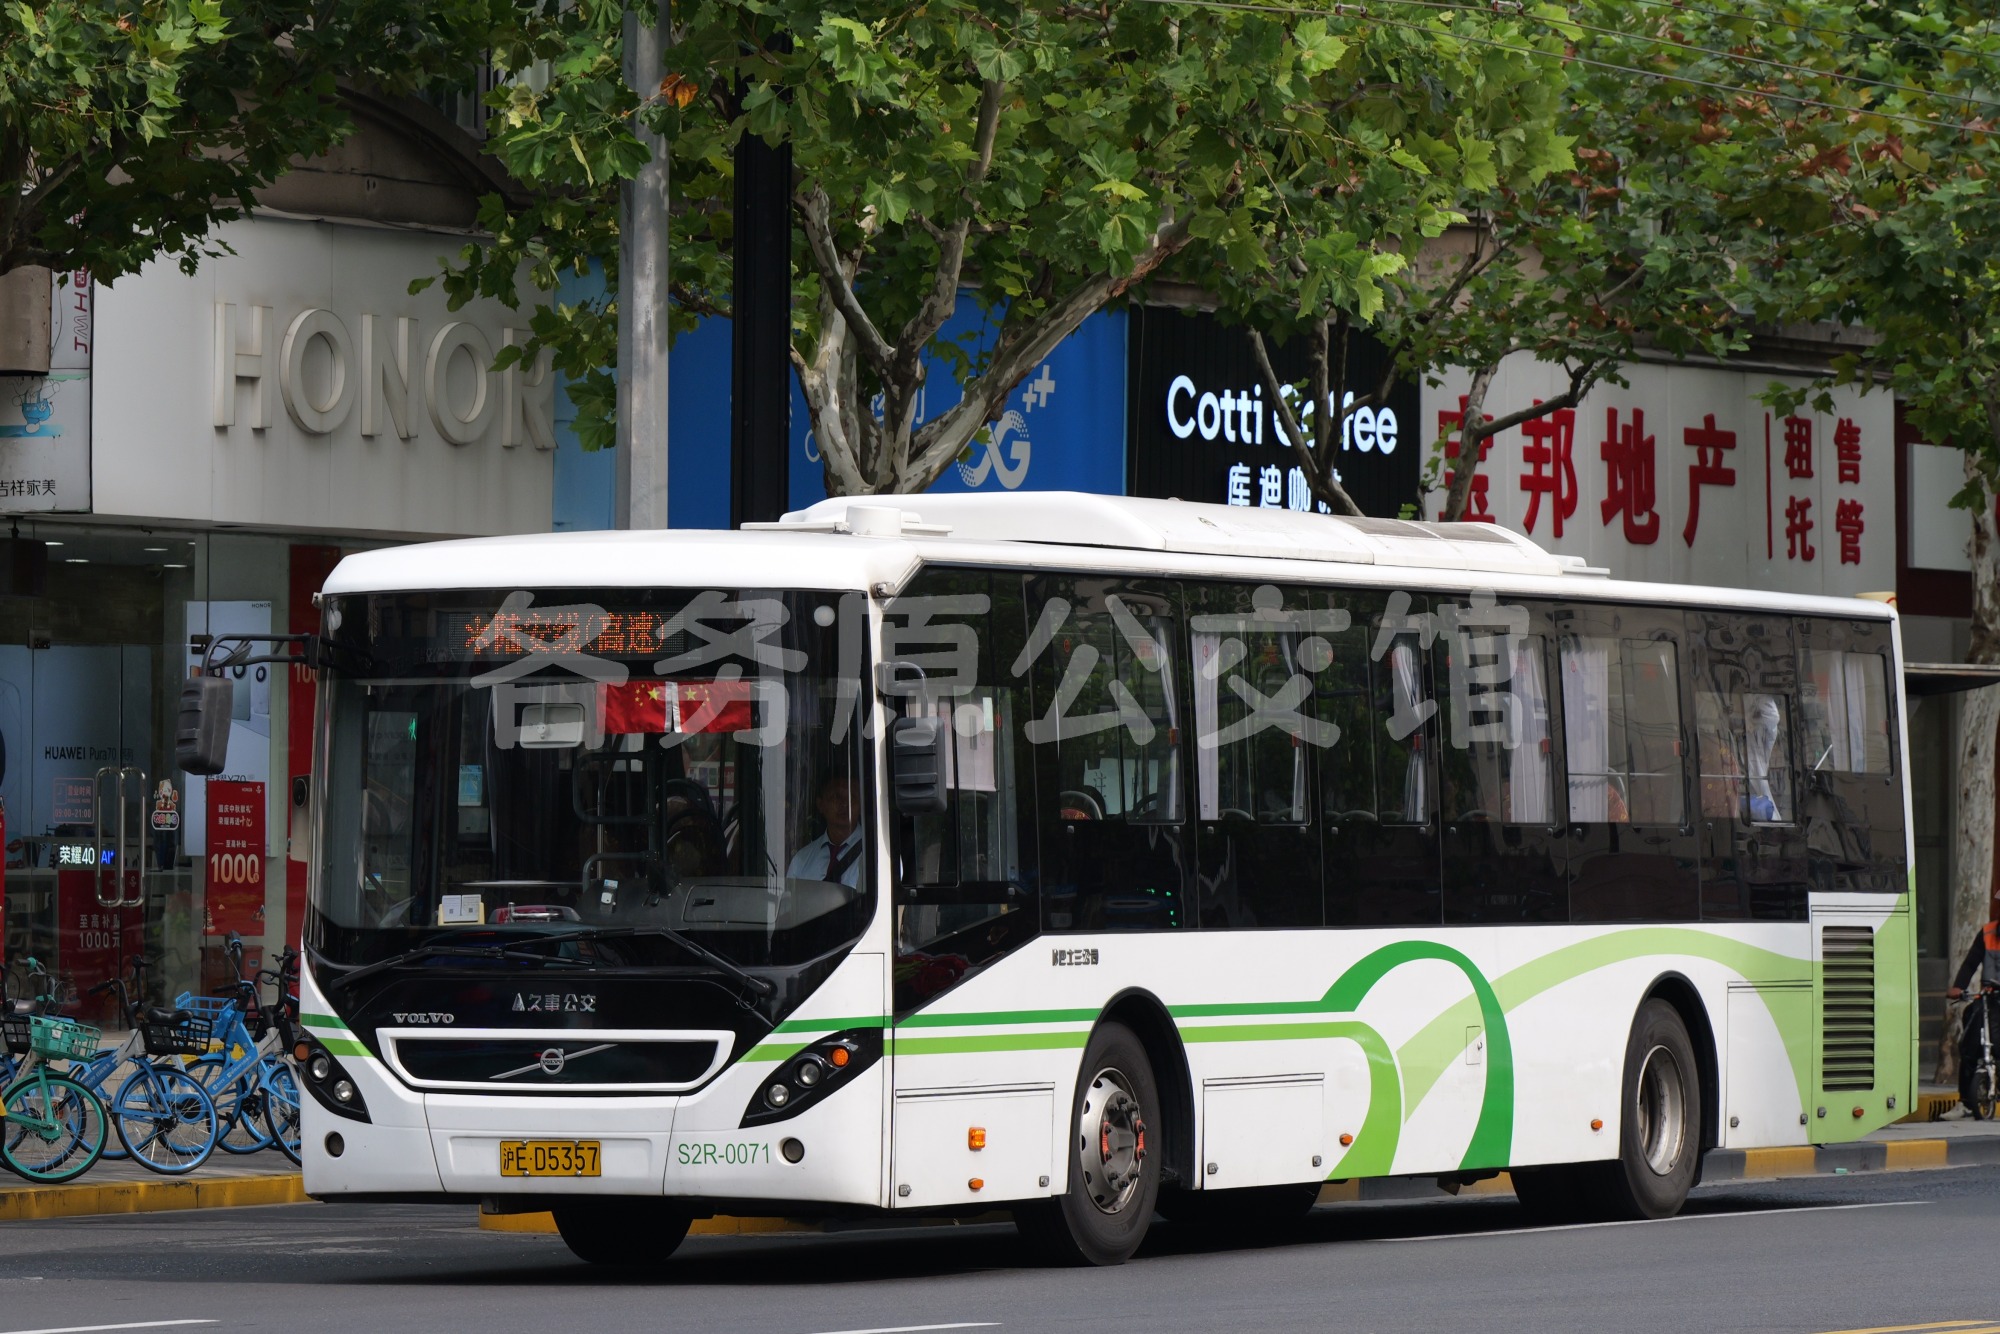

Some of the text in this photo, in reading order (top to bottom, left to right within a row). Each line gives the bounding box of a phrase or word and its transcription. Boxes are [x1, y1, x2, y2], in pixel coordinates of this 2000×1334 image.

[213, 302, 558, 450] HONOR
[1167, 375, 1398, 455] Cotti Cofee
[1227, 461, 1341, 514] 库迪咖
[1438, 394, 1737, 547] 宝邦地产
[44, 746, 86, 760] HUAWEI
[211, 853, 259, 884] 1000
[392, 1012, 455, 1024] VOLVO
[678, 1143, 770, 1165] S2R-0071
